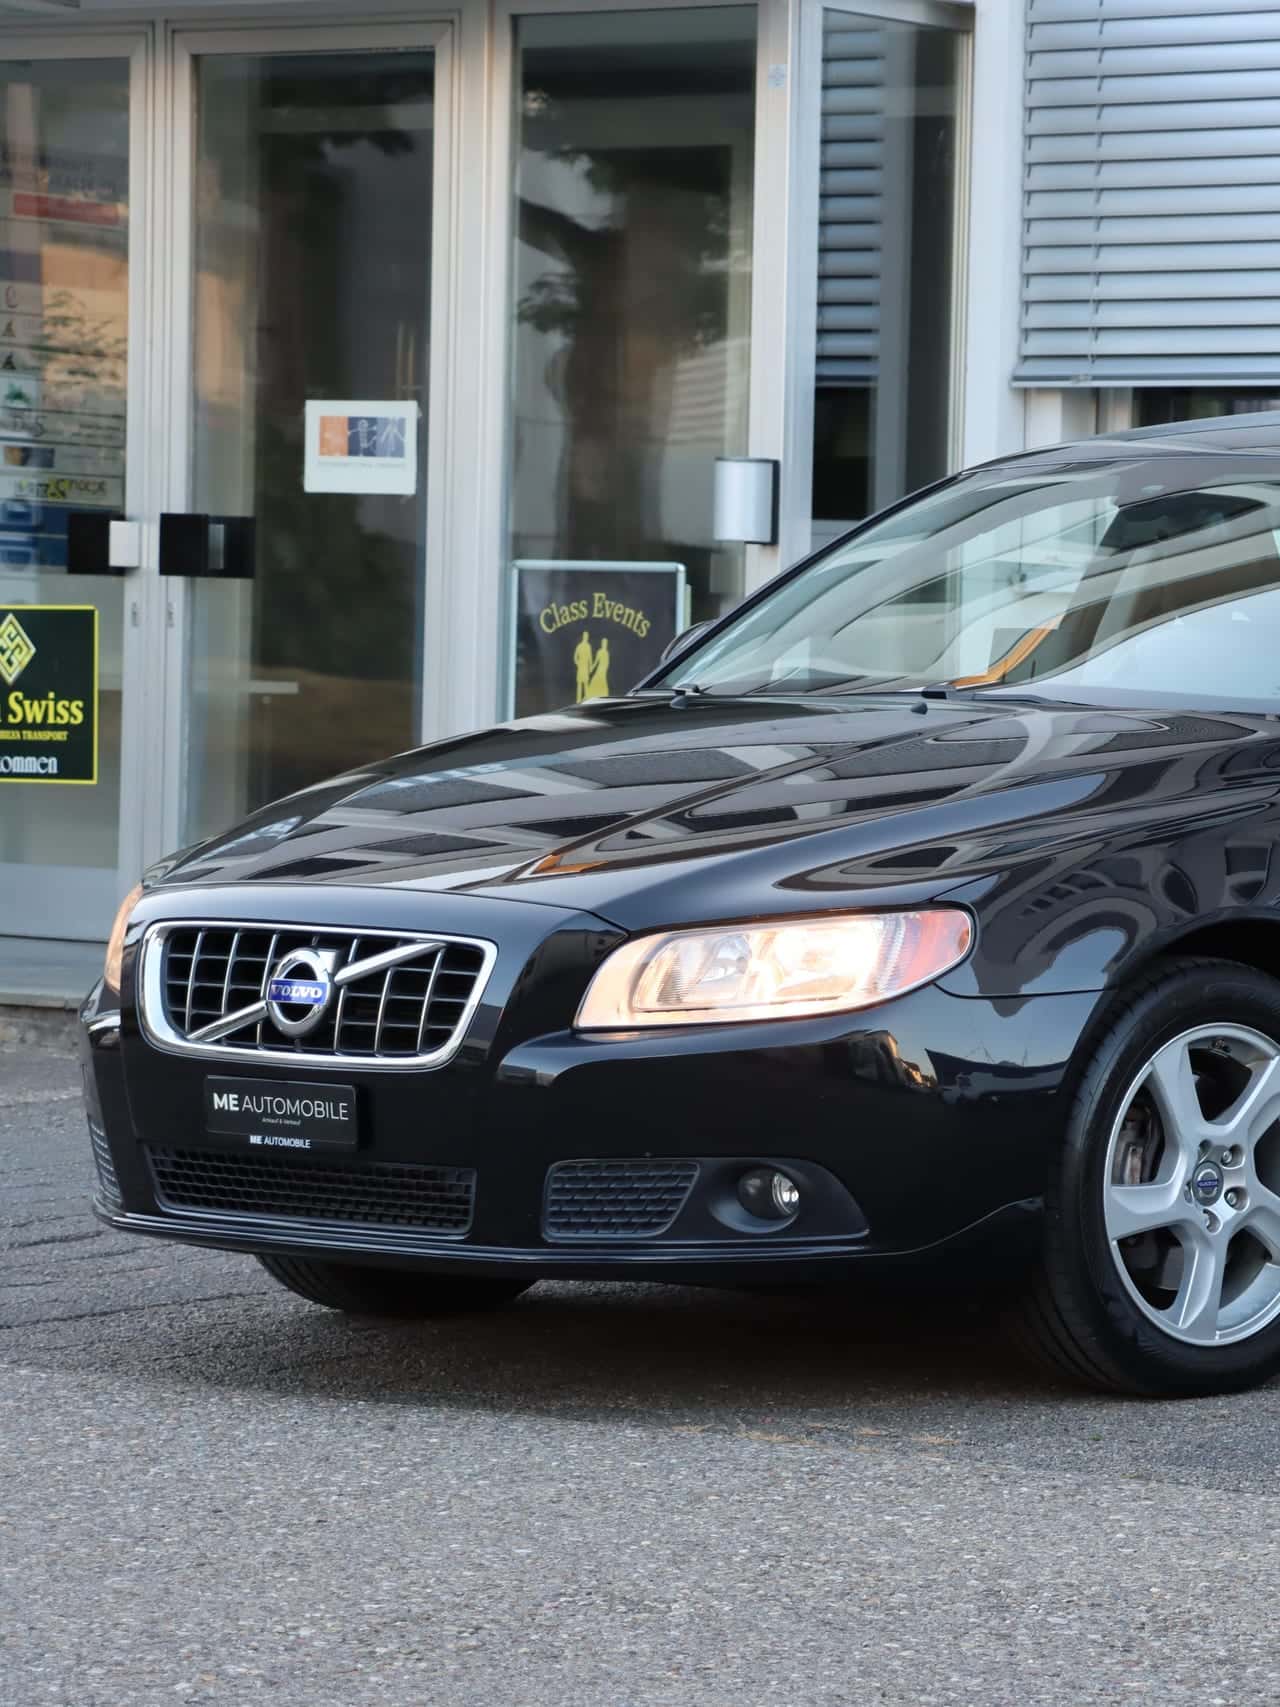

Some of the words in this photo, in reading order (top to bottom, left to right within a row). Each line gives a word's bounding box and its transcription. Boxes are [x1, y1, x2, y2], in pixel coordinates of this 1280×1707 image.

[540, 600, 588, 633] Class
[592, 592, 651, 637] Events
[8, 691, 84, 725] Swiss
[0, 756, 58, 774] ommen
[271, 984, 323, 998] VOLVO
[213, 1092, 239, 1111] ME
[242, 1096, 349, 1120] AUTOMOBILE
[249, 1135, 263, 1145] ME
[264, 1135, 311, 1149] AUTOMOBILE
